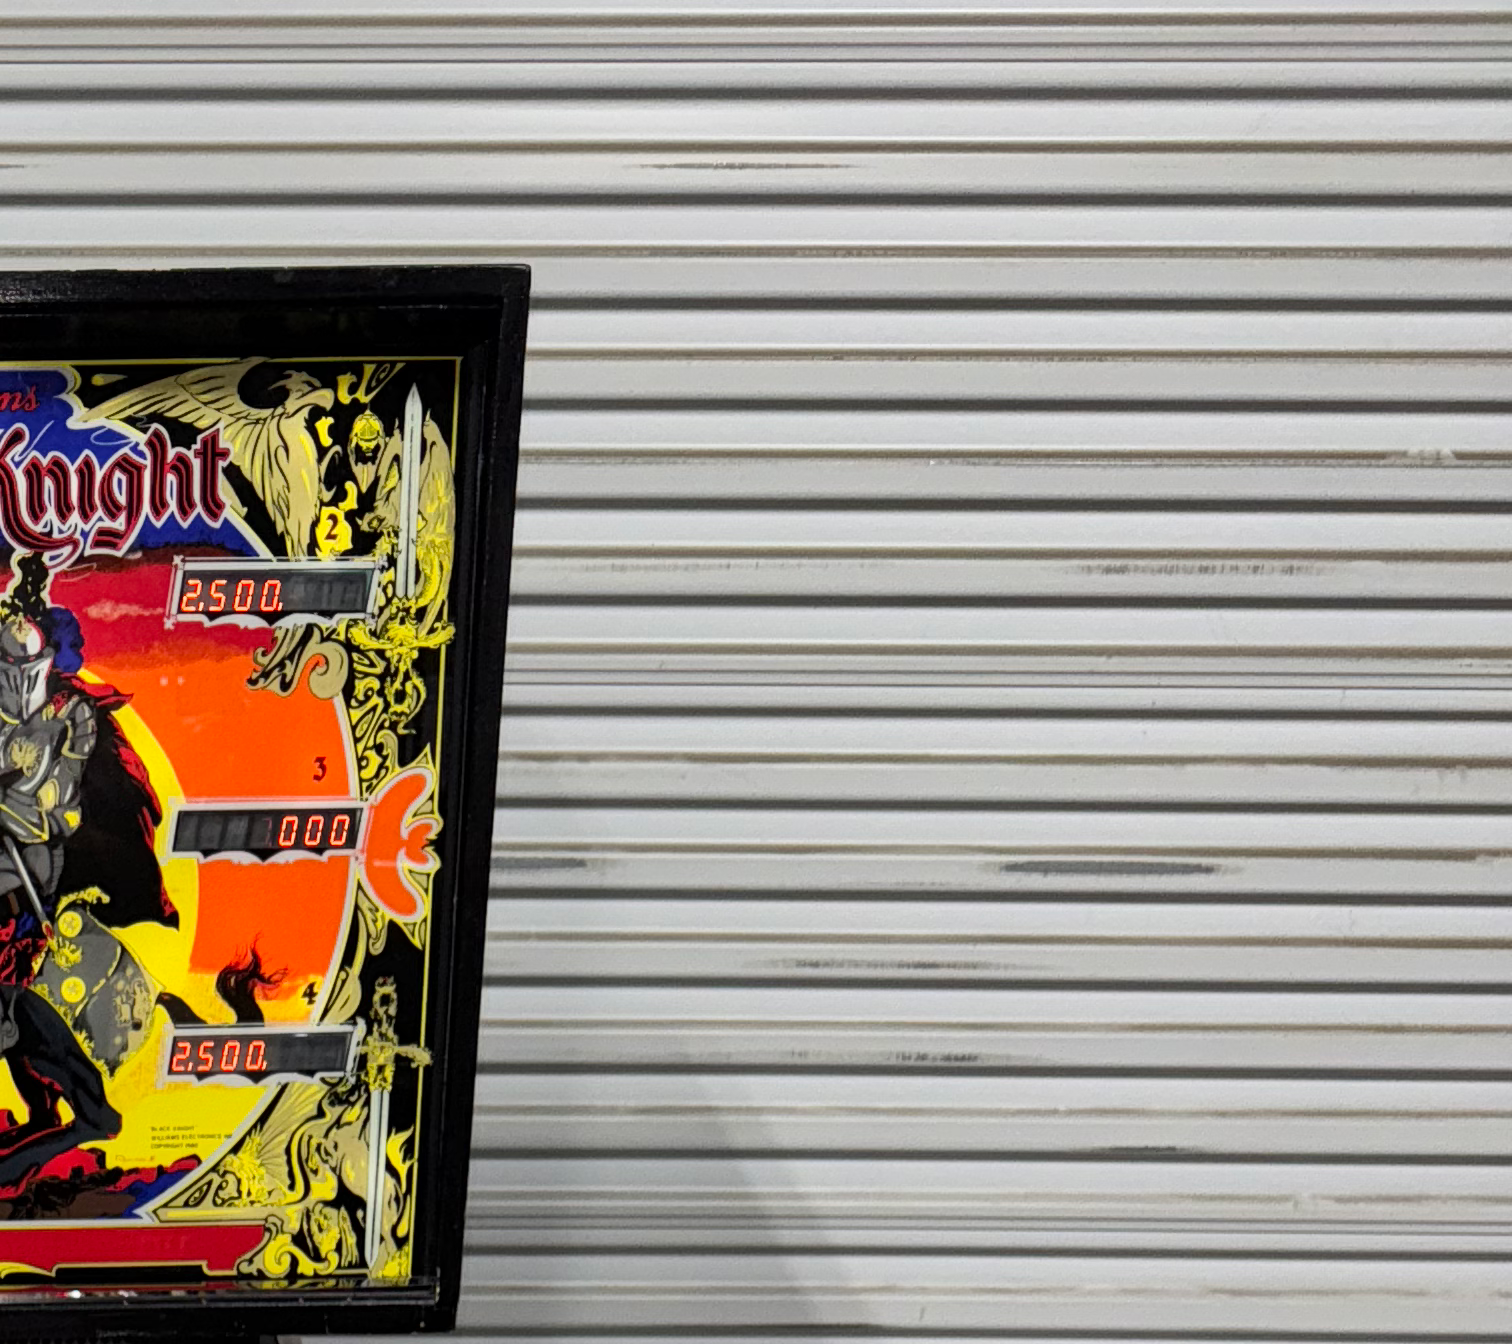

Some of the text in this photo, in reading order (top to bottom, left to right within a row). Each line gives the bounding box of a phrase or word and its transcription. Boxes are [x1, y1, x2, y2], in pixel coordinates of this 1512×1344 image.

[324, 513, 340, 541] 2
[313, 756, 328, 782] 3
[277, 814, 350, 848] 000
[301, 981, 319, 1006] 4
